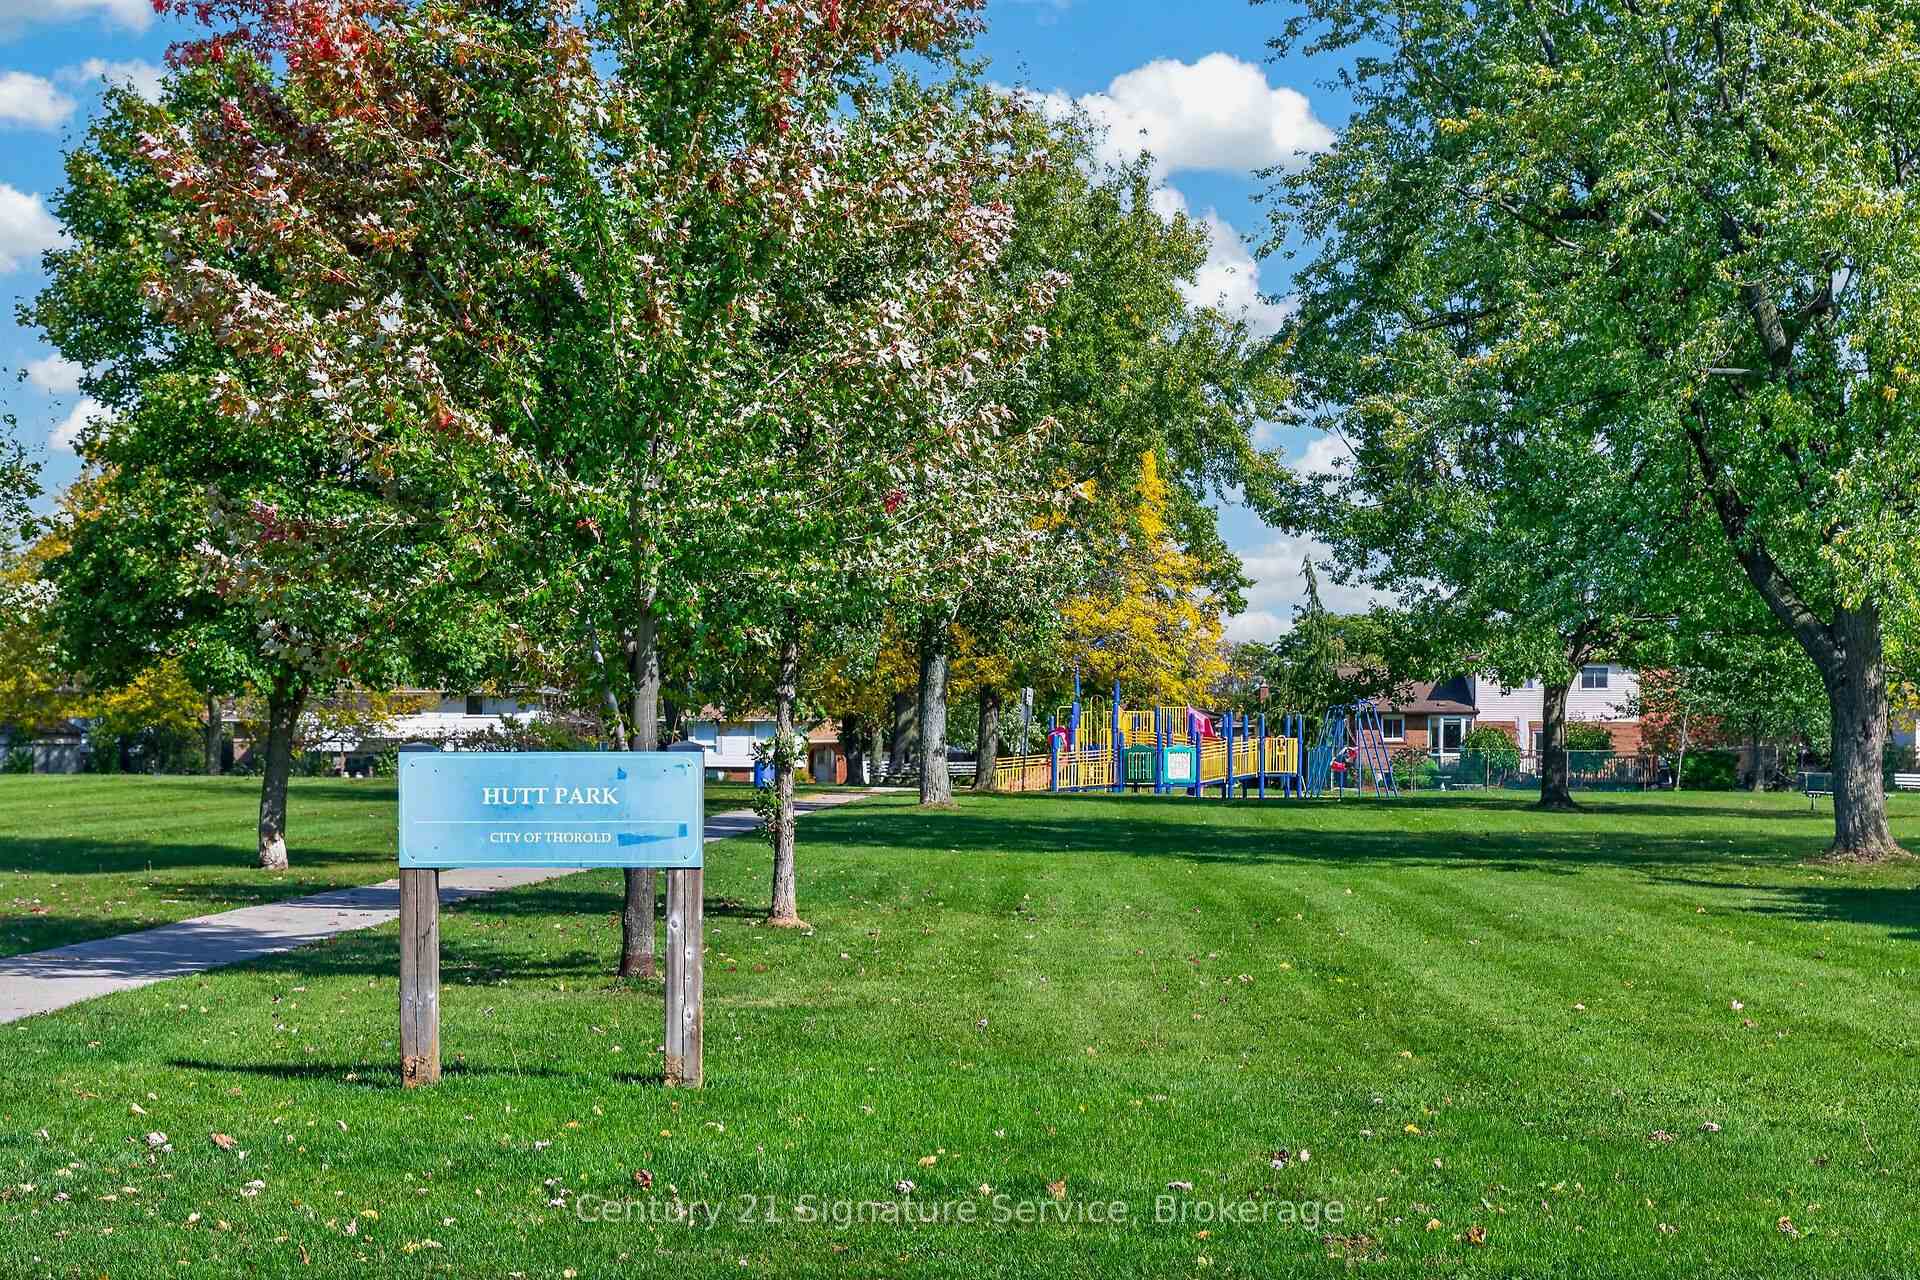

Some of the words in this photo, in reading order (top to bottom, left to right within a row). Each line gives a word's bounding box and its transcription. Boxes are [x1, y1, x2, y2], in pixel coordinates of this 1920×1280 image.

[483, 787, 549, 805] HUTT
[555, 787, 618, 805] PARK
[490, 832, 521, 843] CITY
[525, 832, 542, 843] OF
[545, 832, 611, 843] THOROLD
